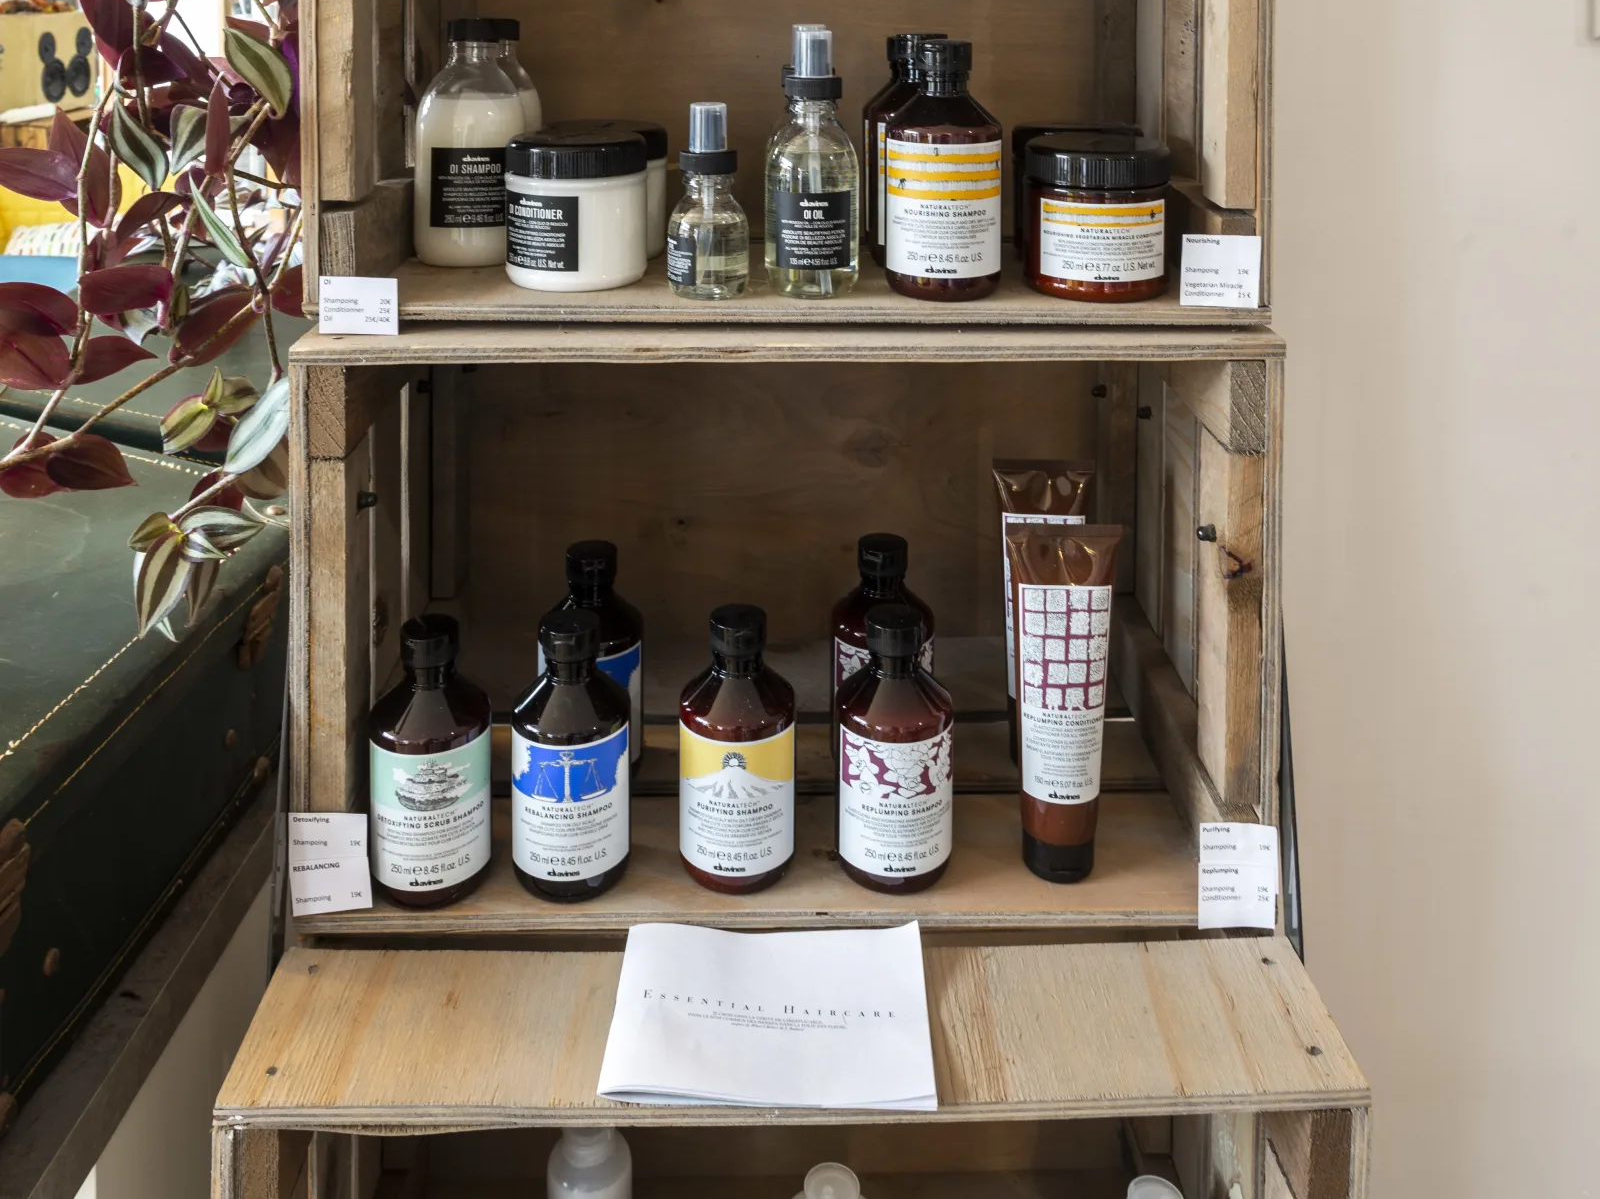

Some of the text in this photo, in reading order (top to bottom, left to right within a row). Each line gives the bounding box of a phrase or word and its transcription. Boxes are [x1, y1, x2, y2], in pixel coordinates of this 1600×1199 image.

[462, 154, 490, 162] davines
[461, 163, 502, 174] SHAMPOO
[799, 198, 829, 207] davines
[514, 205, 563, 220] CONDITIONER
[812, 209, 825, 220] OIL
[904, 208, 987, 217] NOURISHING SHAMPOO
[1043, 229, 1074, 238] NOURISHING
[1136, 230, 1163, 239] CONDITIONER
[1186, 237, 1220, 245] Nourishing
[906, 251, 918, 261] 250
[939, 254, 954, 263] 8.45
[924, 265, 958, 274] davines
[1061, 260, 1074, 270] 250
[1095, 263, 1110, 272] 8.77
[1123, 263, 1136, 272] U.S.
[1185, 266, 1219, 275] Shampoing
[1184, 281, 1218, 289] Vegetarian
[1023, 712, 1063, 726] REPLUMPING
[1048, 790, 1081, 800] davines
[524, 802, 613, 820] REBALANCING SHAMPOO
[696, 801, 773, 816] PURIFYING SHAMPOO
[861, 799, 943, 816] REPLUMPING SHAMPOO
[377, 800, 484, 829] DETOXIFYING SCRUB SHAMPOO
[529, 851, 541, 862] 250
[561, 855, 576, 866] 8.45
[594, 848, 607, 860] U.S.
[696, 844, 708, 856] 250
[726, 852, 742, 862] 8.45
[760, 846, 773, 858] U.S.
[864, 847, 877, 858] 250
[897, 852, 913, 862] 8.45
[928, 843, 940, 856] U.S.
[293, 862, 340, 872] REBALANCING
[391, 863, 402, 874] 250
[424, 864, 439, 875] 8.45
[457, 853, 471, 866] U.S.
[713, 862, 746, 873] davines
[883, 863, 916, 873] davines
[547, 867, 580, 877] davines
[409, 877, 444, 887] davines
[296, 895, 331, 904] Shampoing
[784, 1005, 896, 1018] HAIRCARE
